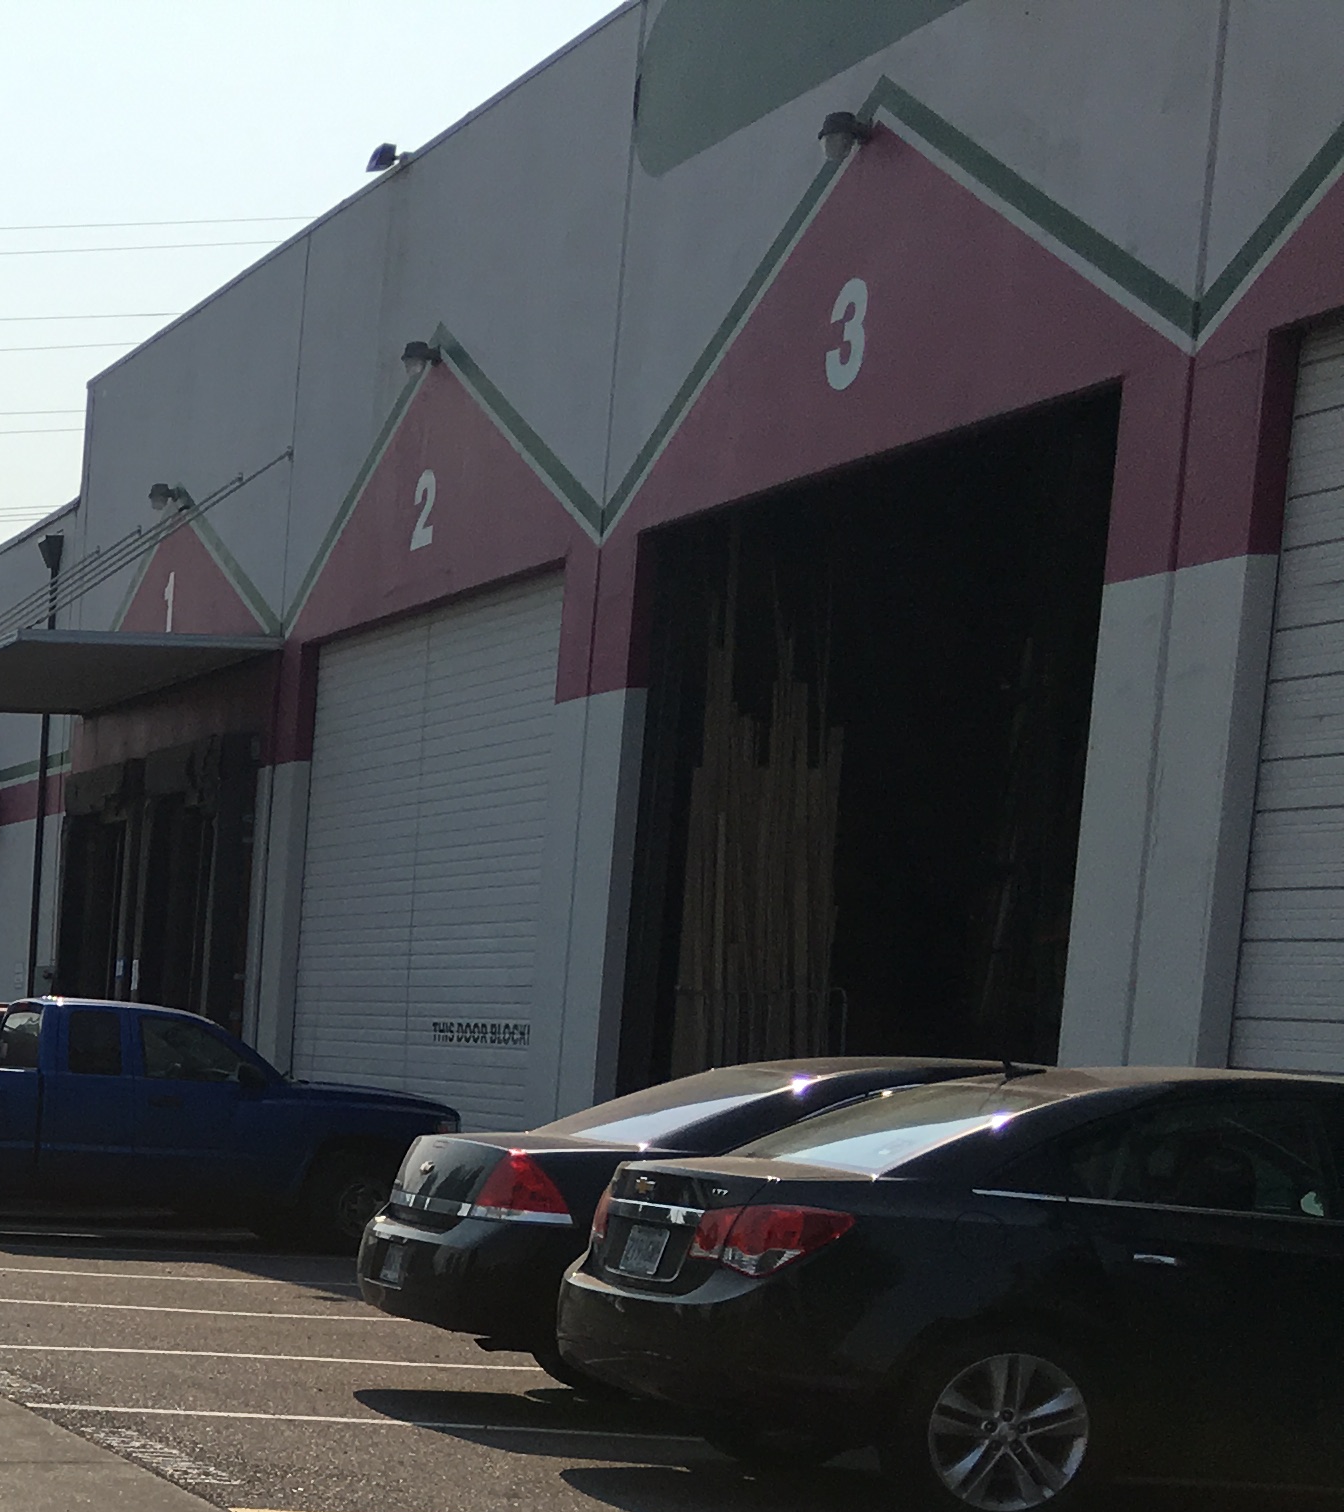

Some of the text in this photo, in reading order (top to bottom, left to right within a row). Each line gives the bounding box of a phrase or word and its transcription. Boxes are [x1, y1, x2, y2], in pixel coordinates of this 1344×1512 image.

[825, 278, 868, 391] 3
[410, 469, 436, 552] 2
[164, 571, 175, 632] 1
[433, 1022, 454, 1043] THIS
[457, 1023, 488, 1044] DOOR
